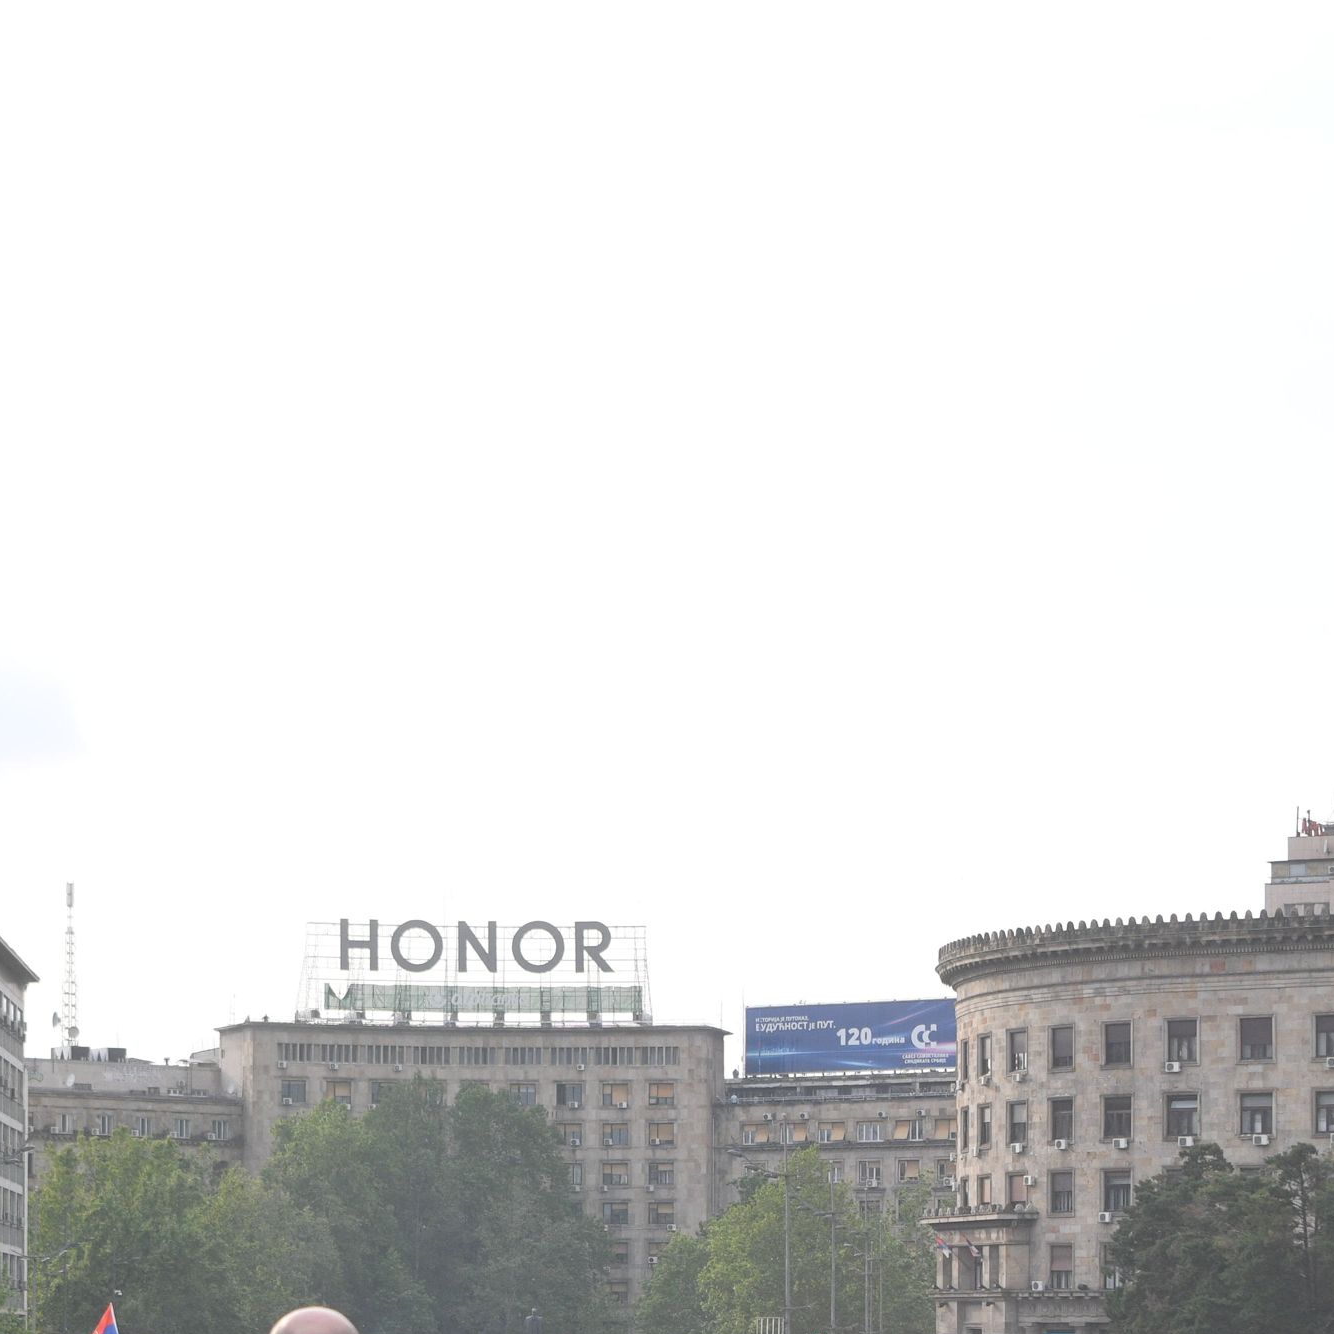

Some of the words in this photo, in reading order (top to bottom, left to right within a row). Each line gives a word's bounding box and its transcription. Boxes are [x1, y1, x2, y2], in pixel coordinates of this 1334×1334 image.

[340, 918, 615, 973] HONOR
[836, 1027, 872, 1046] 120
[872, 1036, 906, 1046] година
